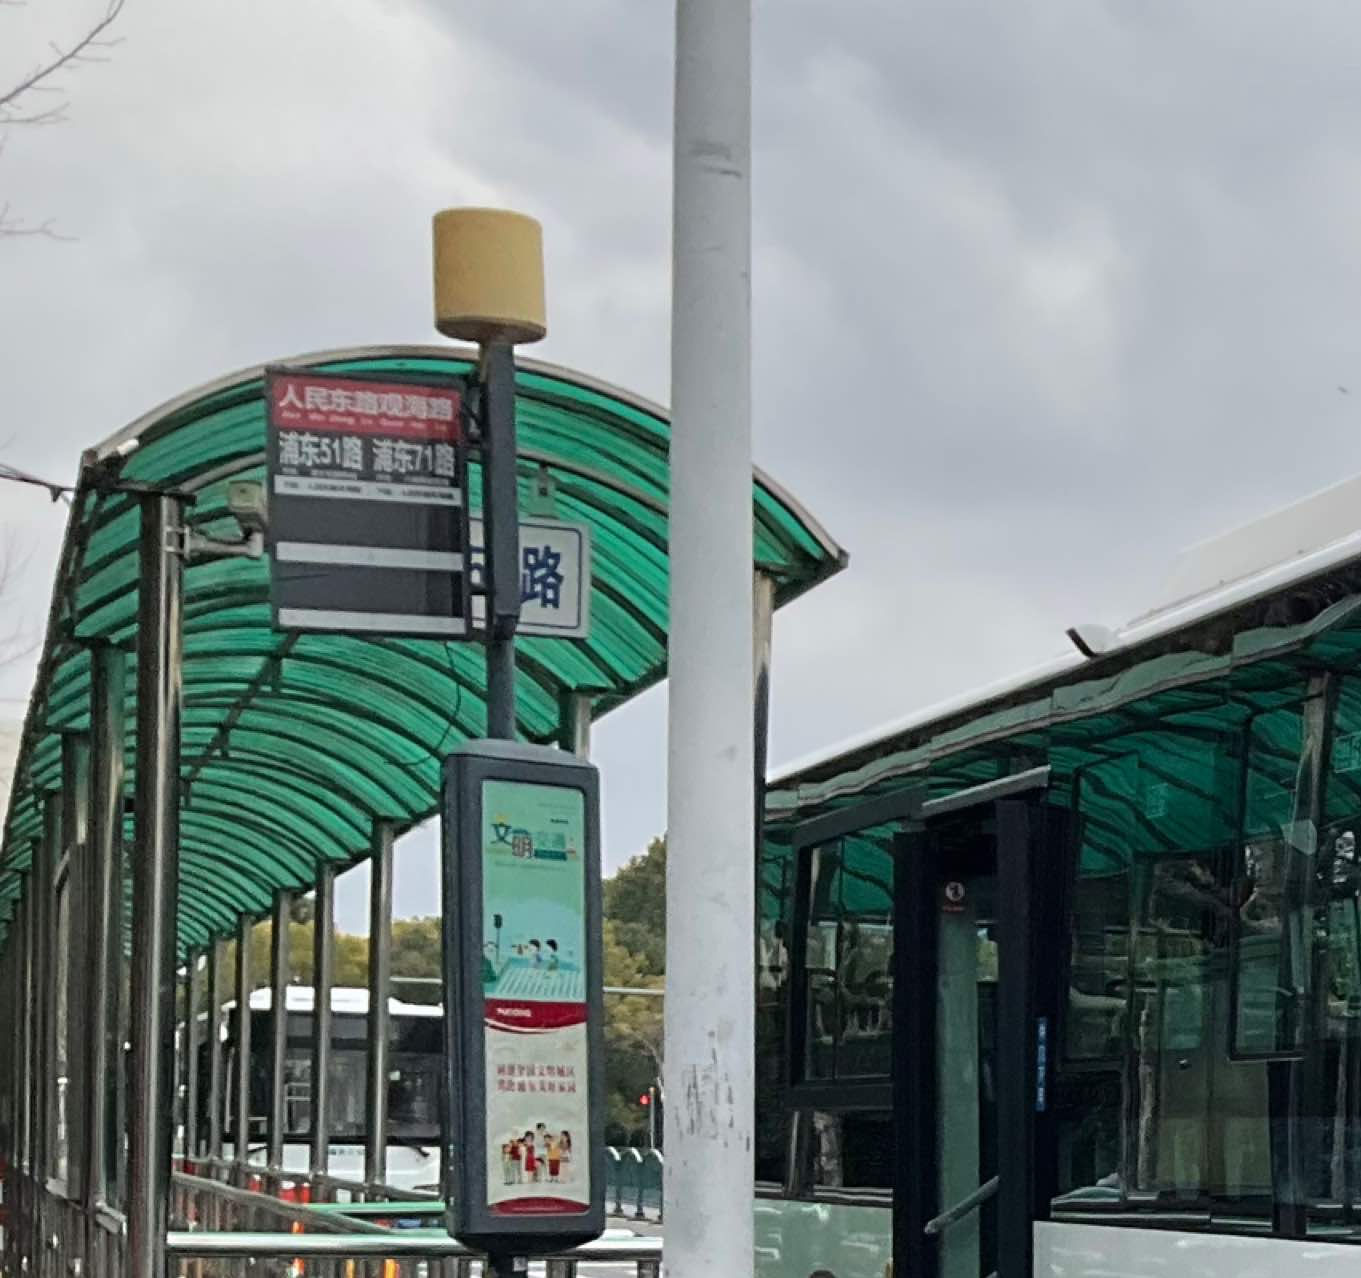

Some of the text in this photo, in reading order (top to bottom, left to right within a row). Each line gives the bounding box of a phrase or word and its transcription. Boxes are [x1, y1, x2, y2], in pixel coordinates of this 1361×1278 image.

[279, 431, 455, 478] 浦东51路 浦东71路
